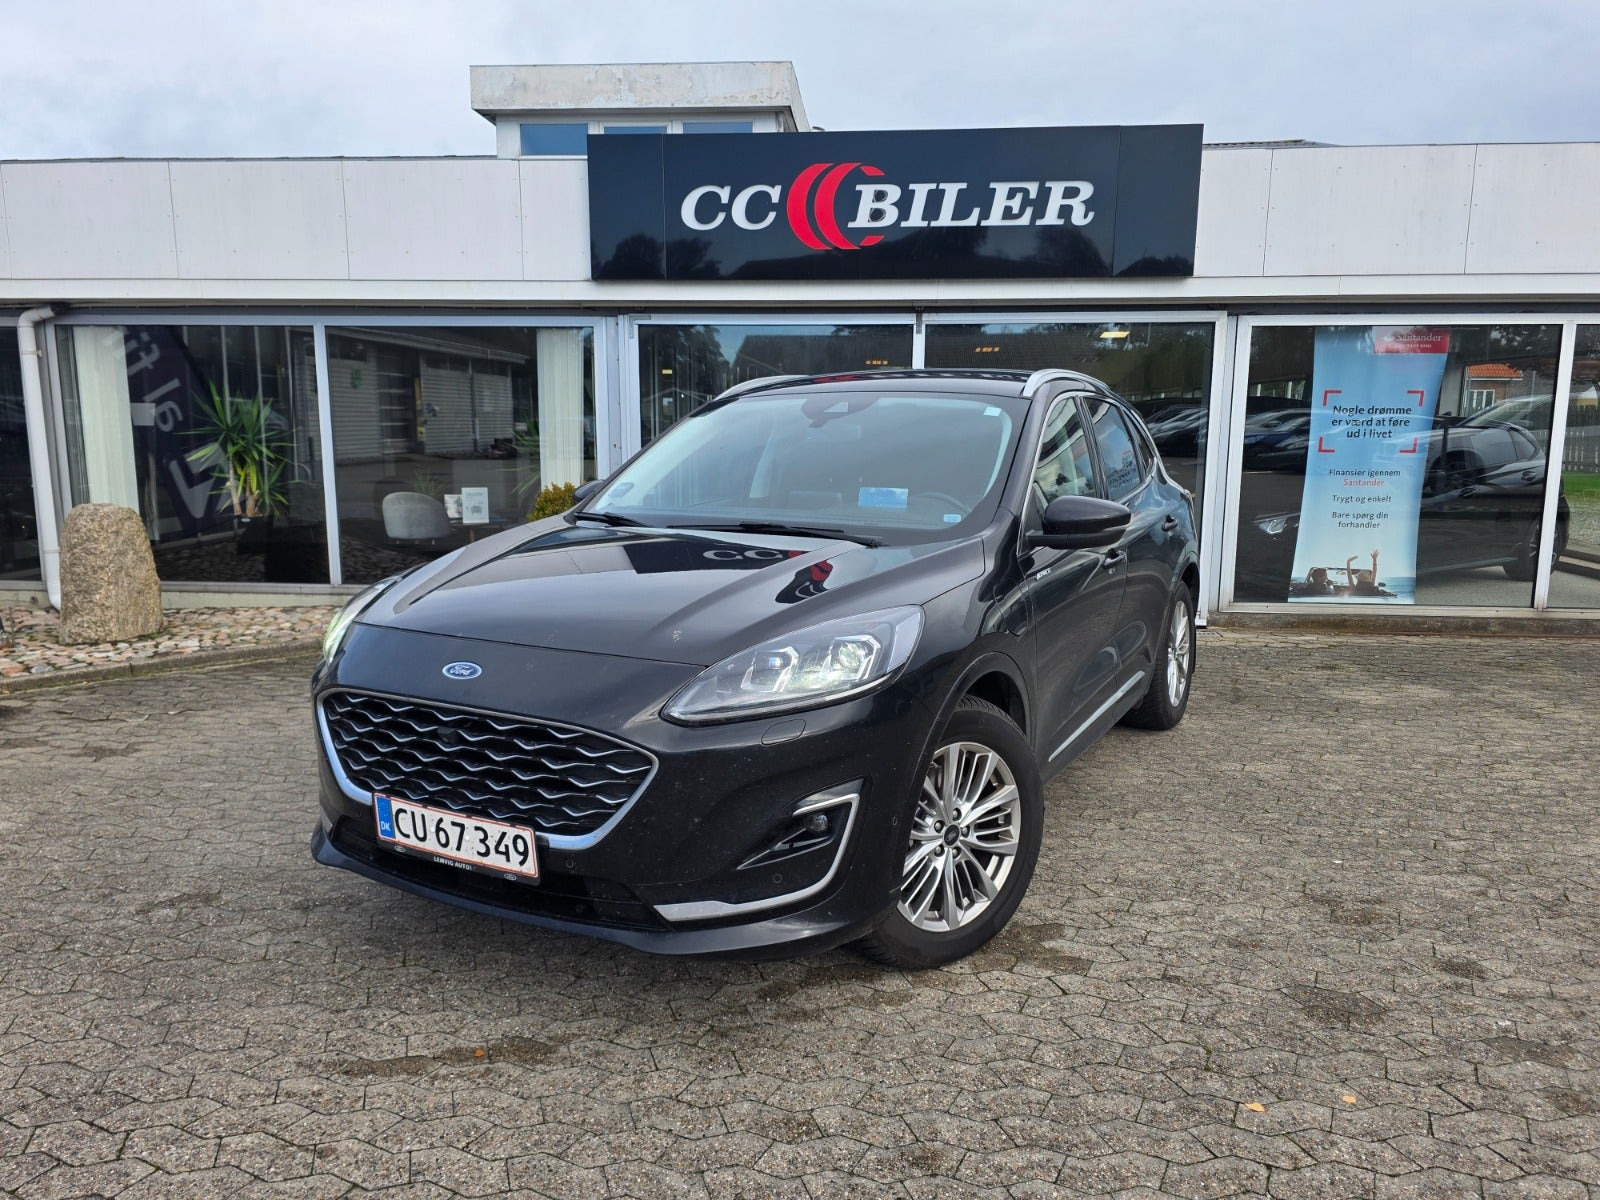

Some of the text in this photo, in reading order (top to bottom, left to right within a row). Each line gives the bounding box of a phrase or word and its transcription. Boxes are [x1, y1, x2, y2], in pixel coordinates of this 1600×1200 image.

[681, 180, 1096, 231] CC BILER
[1333, 405, 1412, 417] Nogle drømme
[1331, 417, 1410, 427] er værd at føre
[1346, 428, 1360, 438] ud
[1369, 428, 1393, 438] livet
[1328, 468, 1401, 478] Finansier igennem
[1343, 478, 1385, 486] Santander
[1332, 494, 1392, 504] Trygt og enkelt
[1332, 511, 1389, 520] Bare spørg din
[1338, 520, 1381, 529] forhandler
[380, 821, 391, 832] DK
[474, 825, 529, 867] 349
